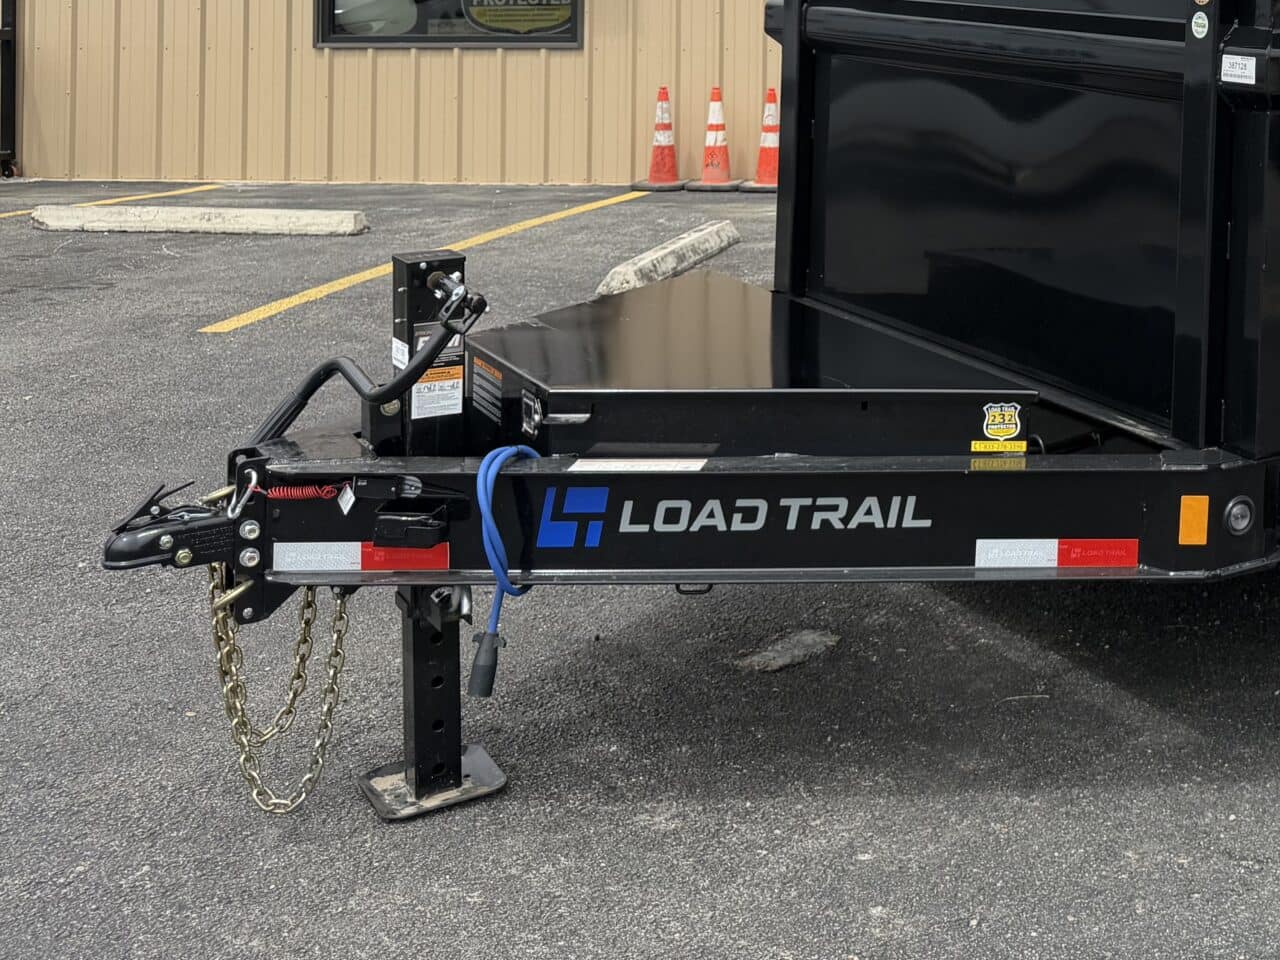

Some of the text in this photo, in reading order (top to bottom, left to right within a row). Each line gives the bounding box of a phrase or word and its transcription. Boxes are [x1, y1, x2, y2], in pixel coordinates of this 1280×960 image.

[991, 413, 1013, 423] 232
[618, 498, 769, 533] LOAD
[779, 495, 932, 530] TRAIL
